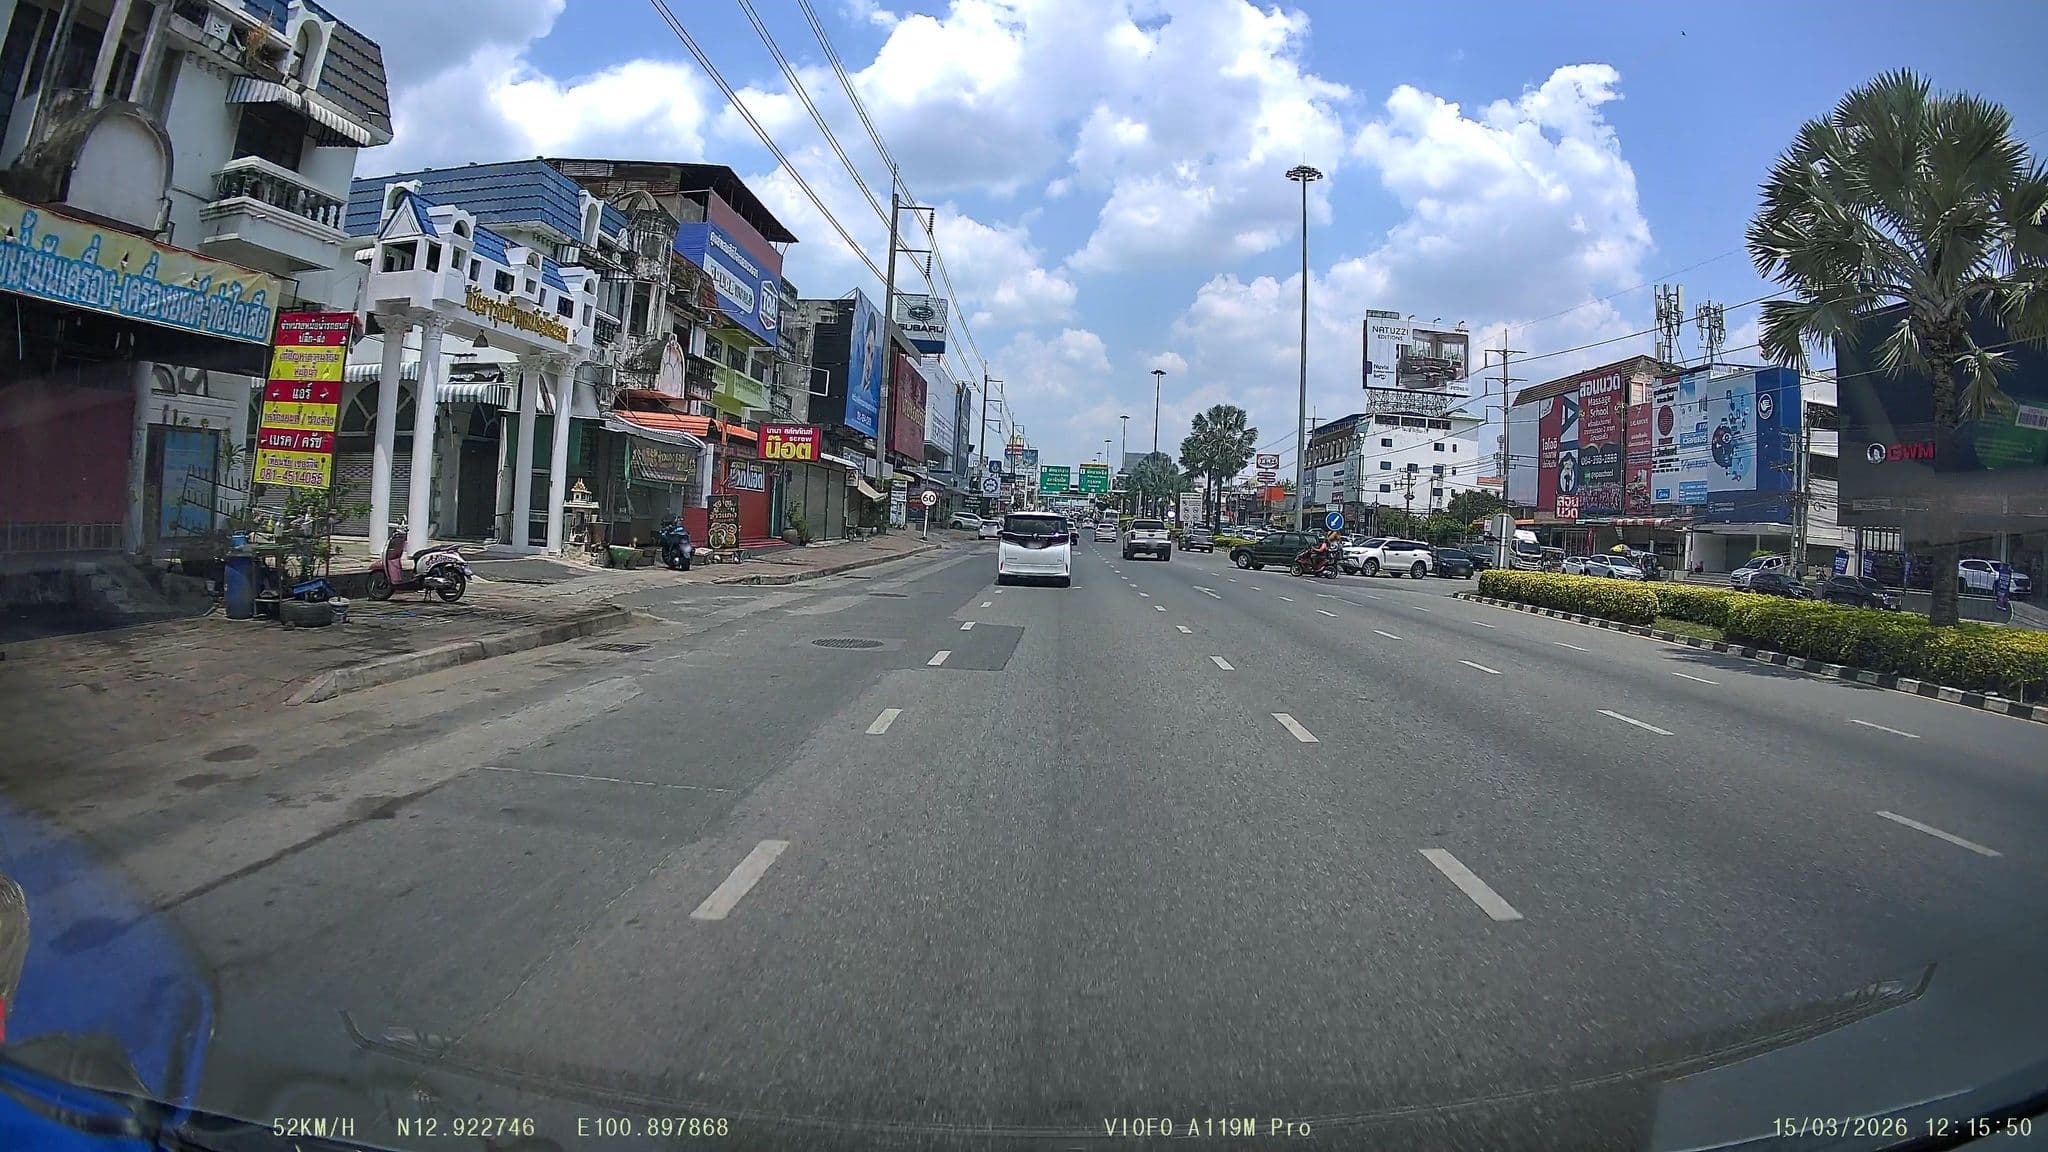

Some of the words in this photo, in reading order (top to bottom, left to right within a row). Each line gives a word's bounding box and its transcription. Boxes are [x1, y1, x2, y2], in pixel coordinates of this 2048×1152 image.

[898, 322, 944, 334] SUBARU
[1372, 325, 1409, 336] NATUZZI
[292, 382, 313, 400] แอร์
[1579, 374, 1621, 397] สอนนวด
[1587, 395, 1612, 407] Massage
[1590, 406, 1609, 418] School
[269, 434, 293, 447] เบรค
[1887, 443, 1934, 461] GWM
[922, 494, 936, 502] 60
[1557, 495, 1579, 507] สอน
[1556, 507, 1579, 519] นวด
